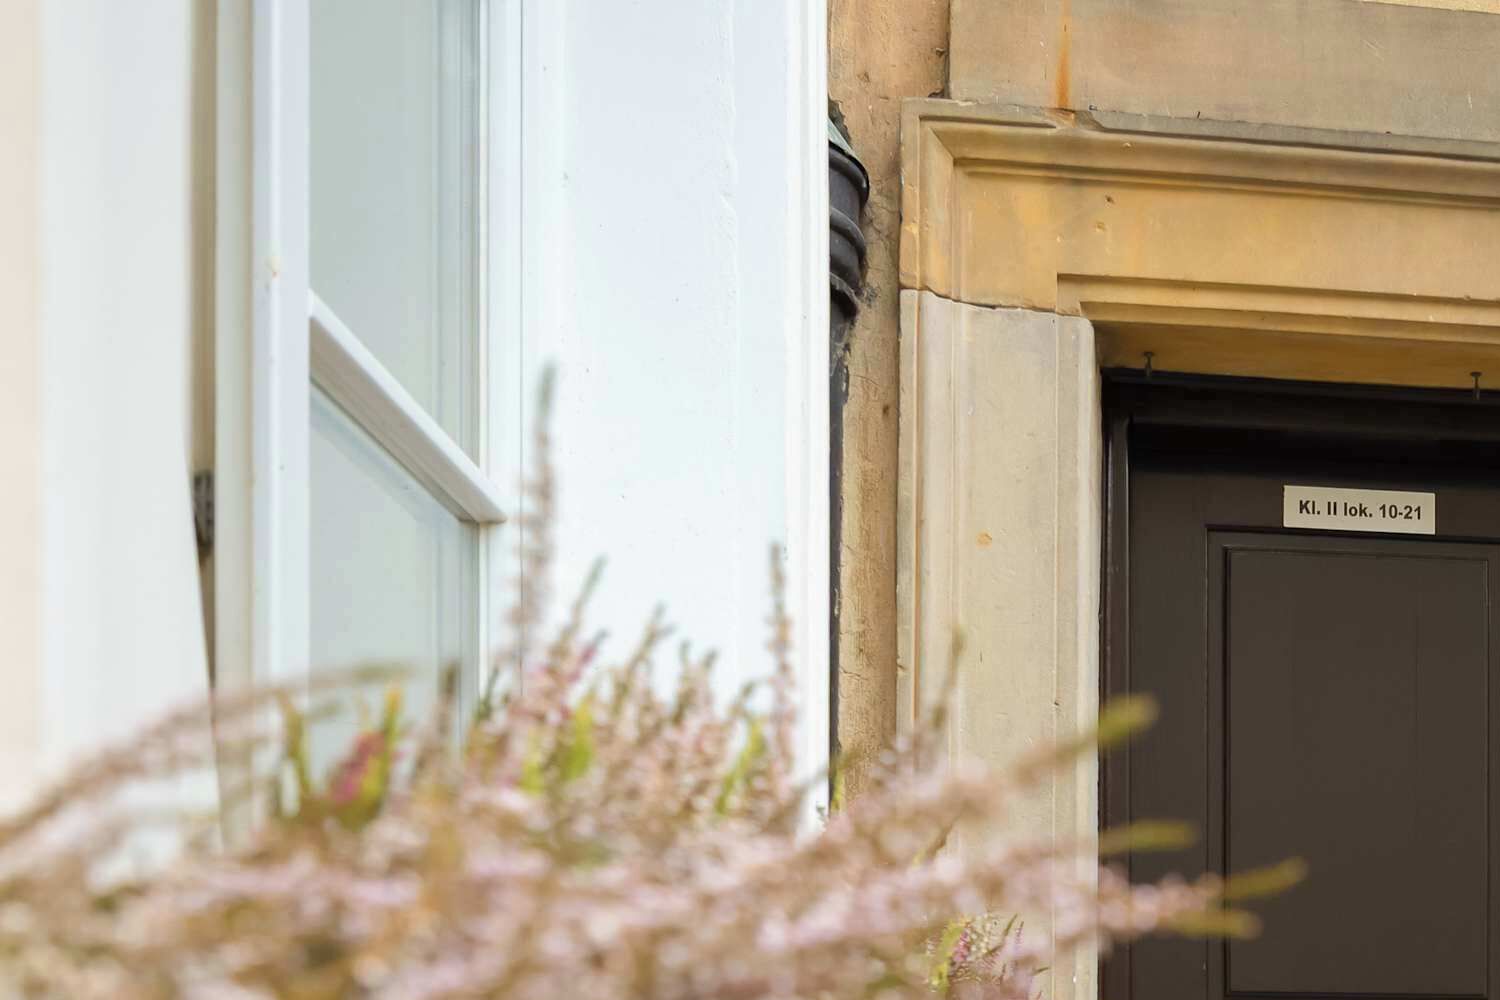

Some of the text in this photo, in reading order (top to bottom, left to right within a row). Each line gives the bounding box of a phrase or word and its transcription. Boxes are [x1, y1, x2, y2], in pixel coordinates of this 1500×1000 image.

[1327, 501, 1337, 516] II
[1343, 502, 1373, 518] lok.
[1379, 504, 1422, 520] 10-21
